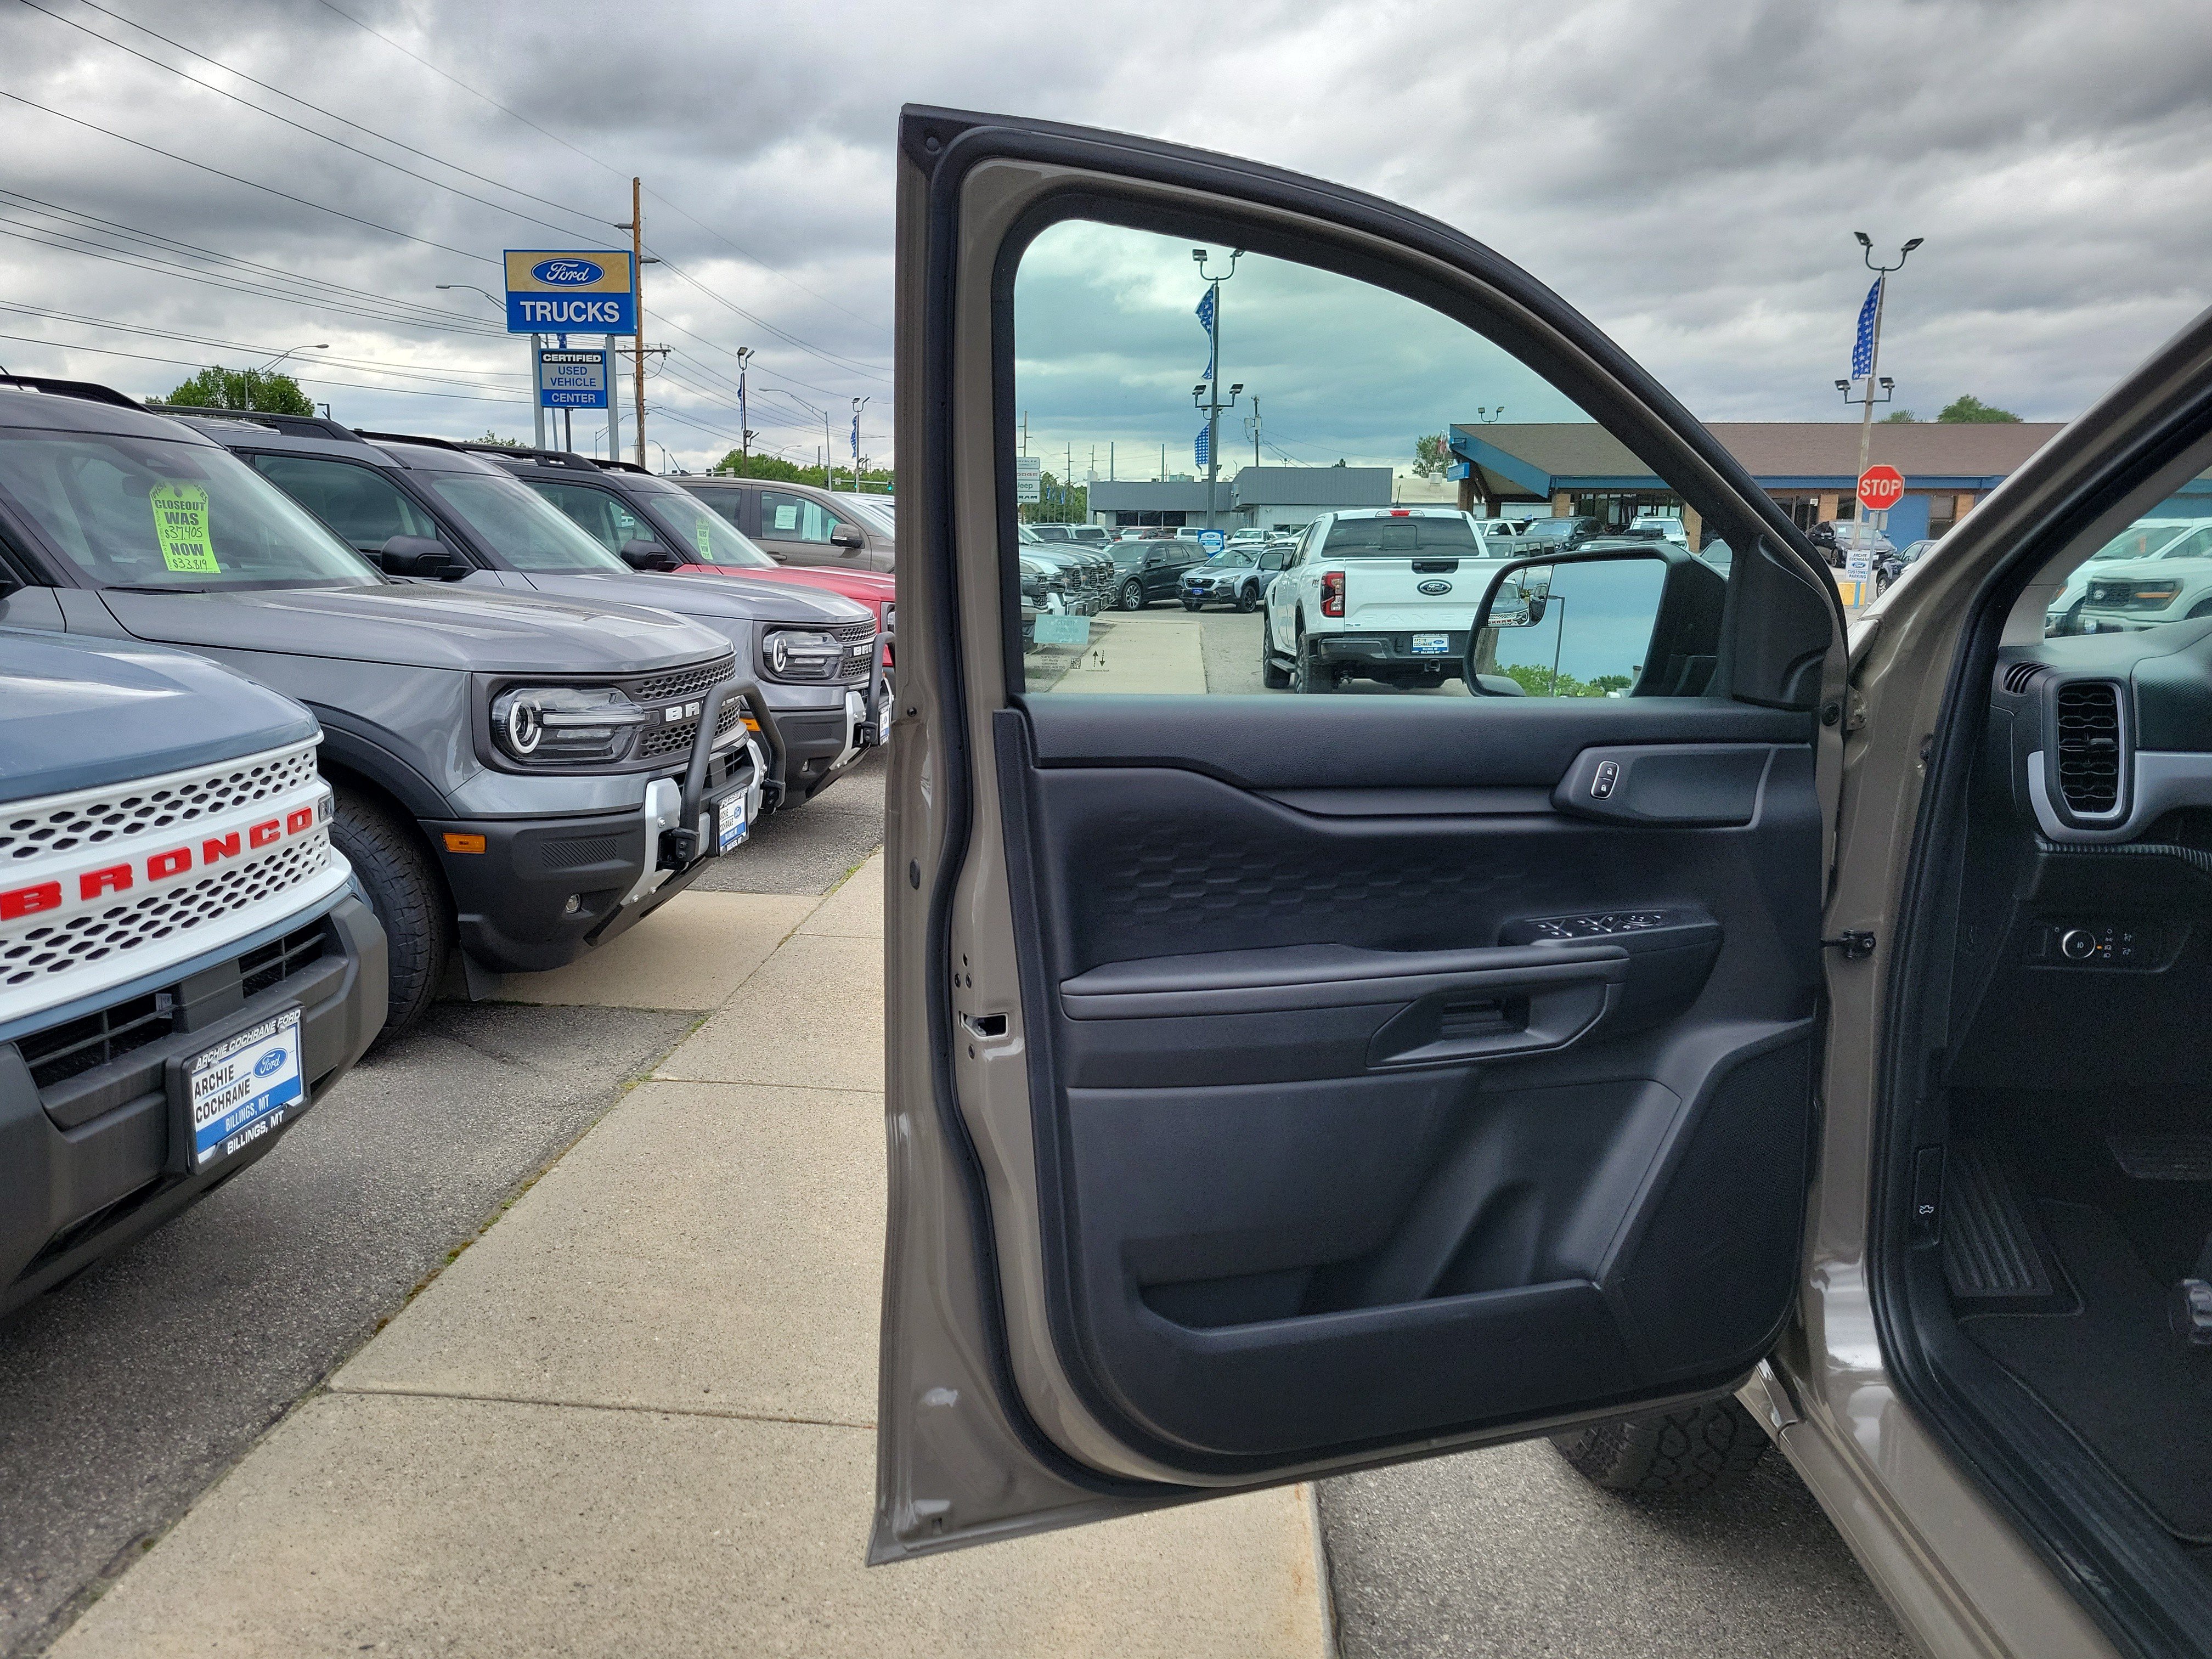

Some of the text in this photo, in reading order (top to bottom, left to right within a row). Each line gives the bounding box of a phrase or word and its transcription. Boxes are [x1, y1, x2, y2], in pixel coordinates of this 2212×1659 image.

[546, 262, 590, 281] Ford
[520, 301, 620, 323] TRUCKS
[543, 354, 601, 363] CERTIFIED
[558, 366, 588, 375] USED
[550, 377, 596, 387] VEHICLE
[551, 393, 596, 403] CENTER
[1018, 482, 1033, 490] Jeep
[1860, 479, 1902, 496] STOP
[154, 499, 205, 511] CLOSEOUT
[164, 511, 199, 526] WAS
[170, 543, 205, 556] NOW
[0, 807, 313, 921] BRONCO
[196, 1009, 301, 1070] ARCHIE COCHRANE FORD
[260, 1053, 280, 1074] Ford
[195, 1064, 234, 1100] ARCHIE
[196, 1078, 250, 1124] COCHRANE
[225, 1094, 270, 1132] BILLINGS, MT
[227, 1110, 284, 1155] BILLINGS, MT
